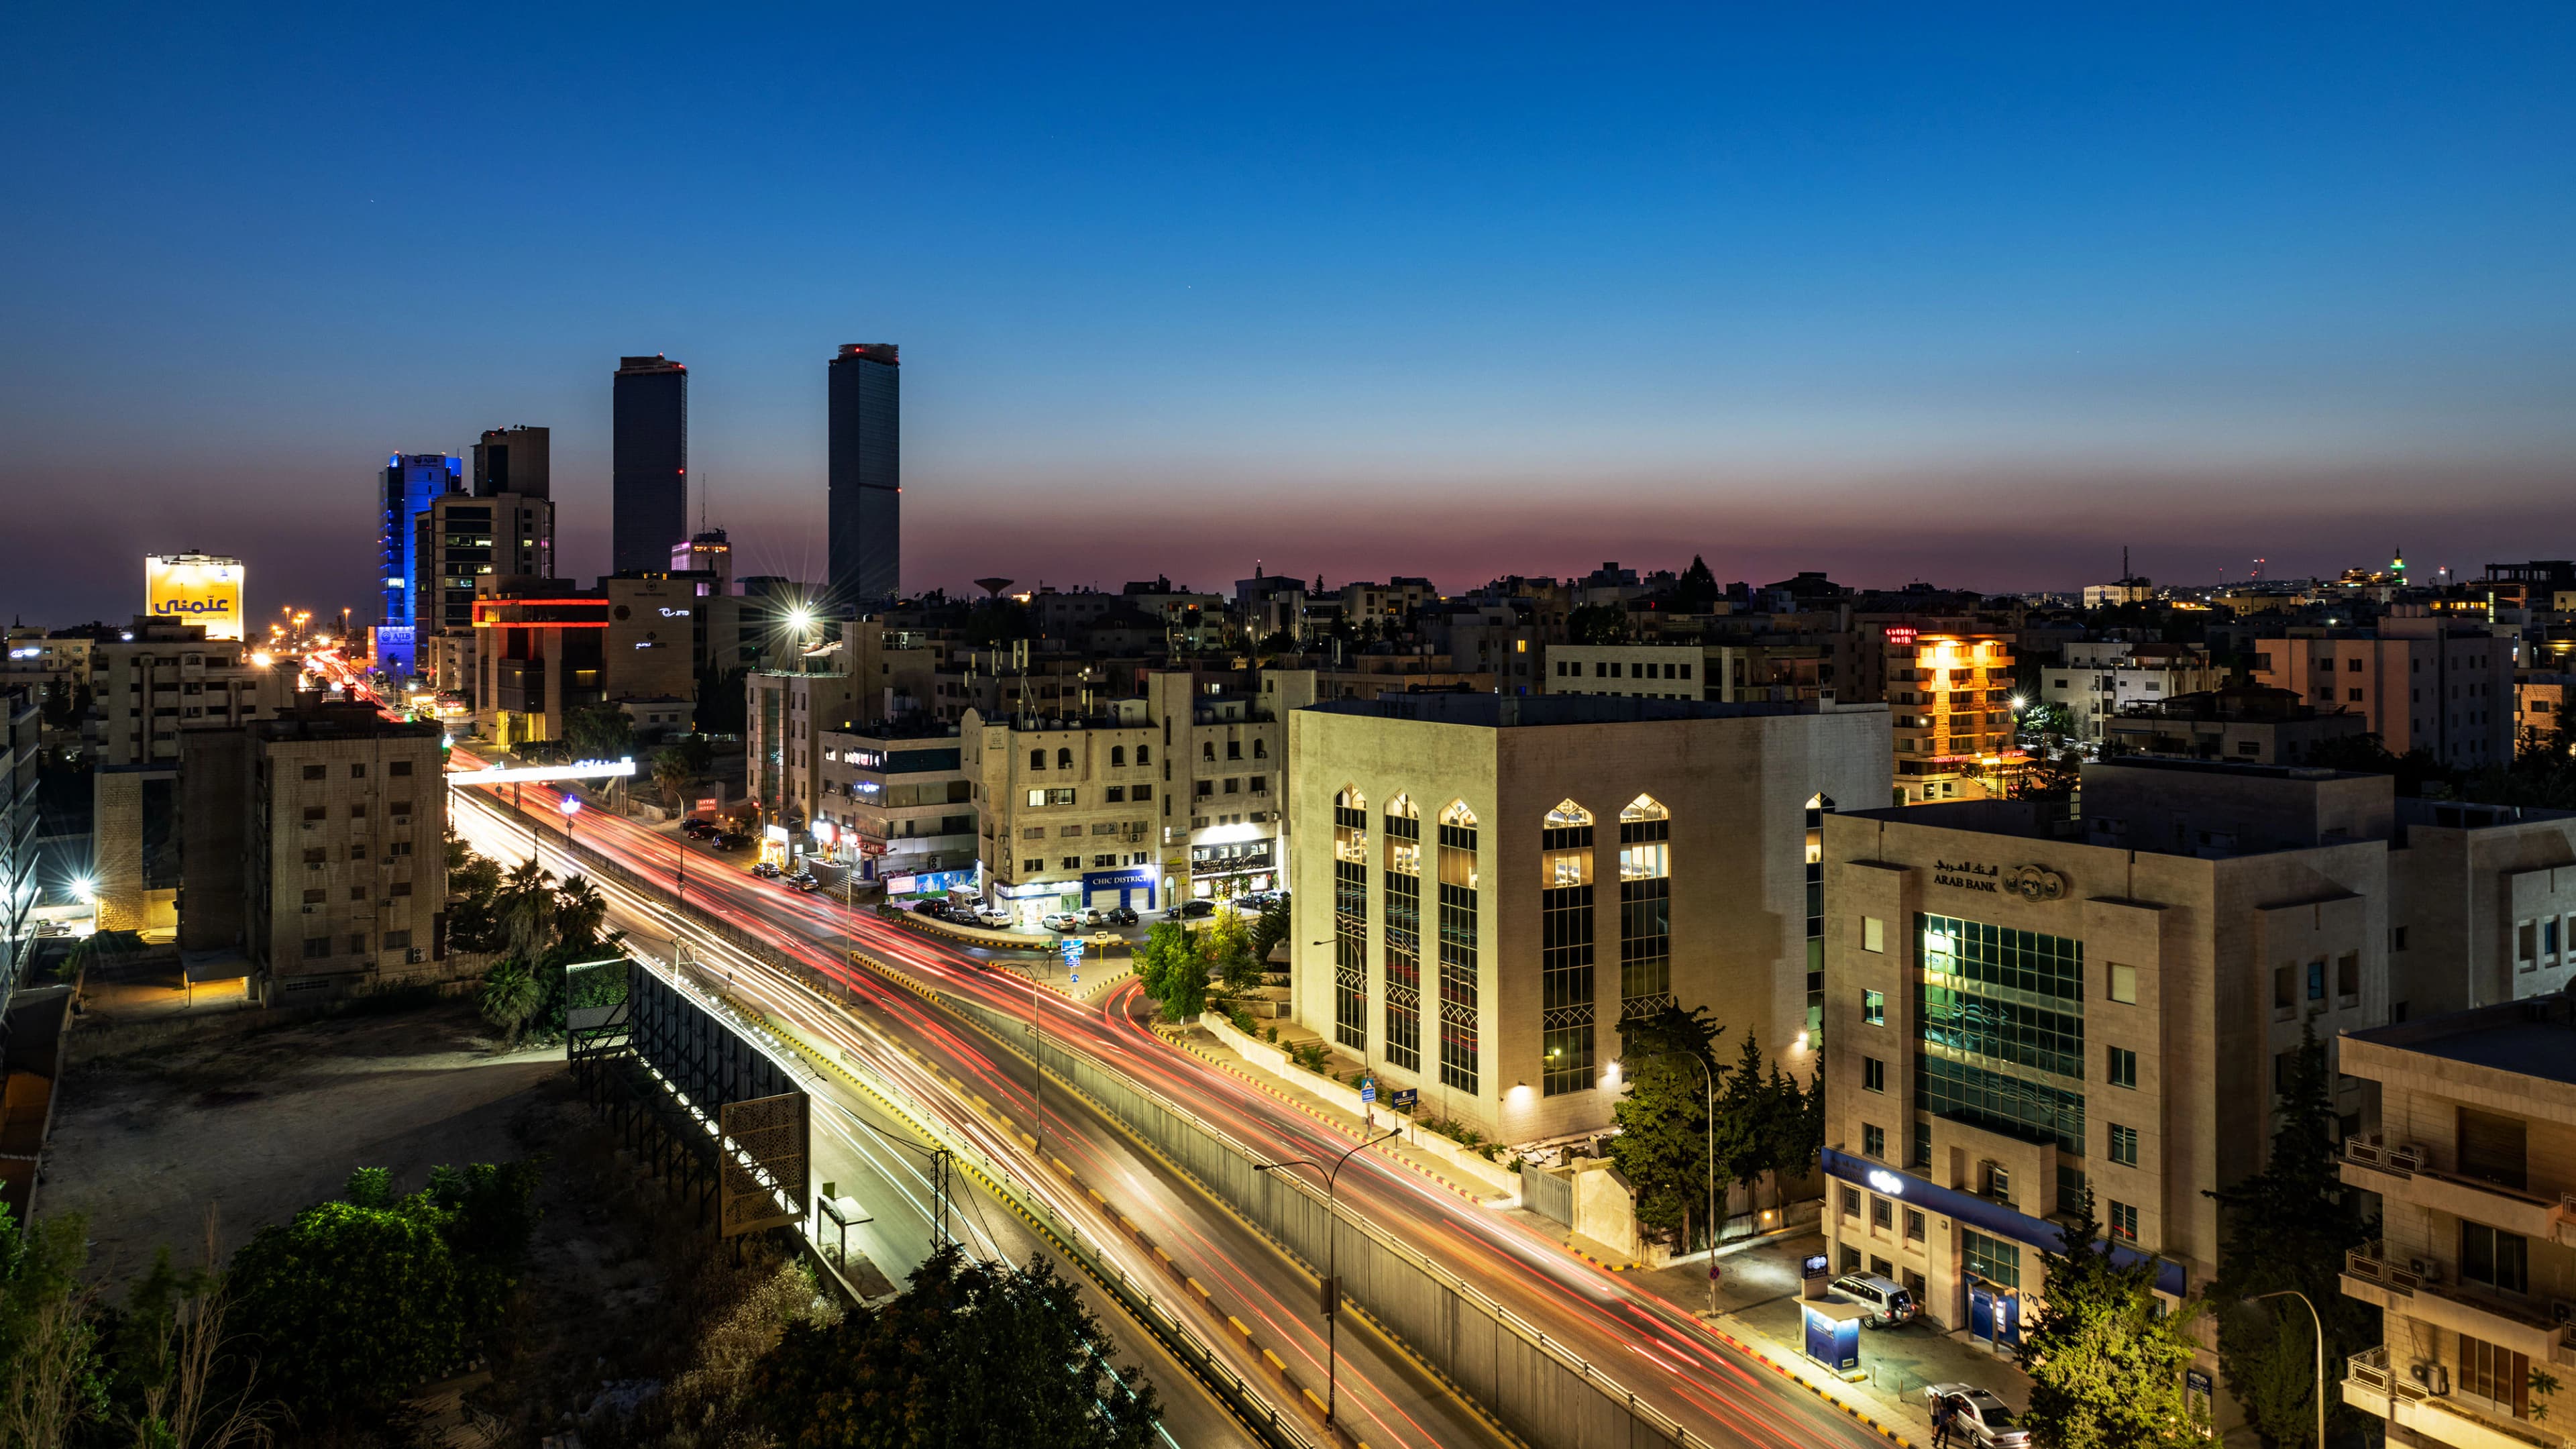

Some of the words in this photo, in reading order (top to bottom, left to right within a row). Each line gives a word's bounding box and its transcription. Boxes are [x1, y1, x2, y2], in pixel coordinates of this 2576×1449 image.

[393, 633, 410, 642] AJIB
[1891, 636, 1911, 644] HOTEL
[1933, 859, 1971, 872] العربي
[1972, 863, 1998, 878] البنك
[1114, 874, 1147, 883] DISTRICT
[1933, 874, 1964, 888] ARAB
[1966, 879, 1998, 893] BANK
